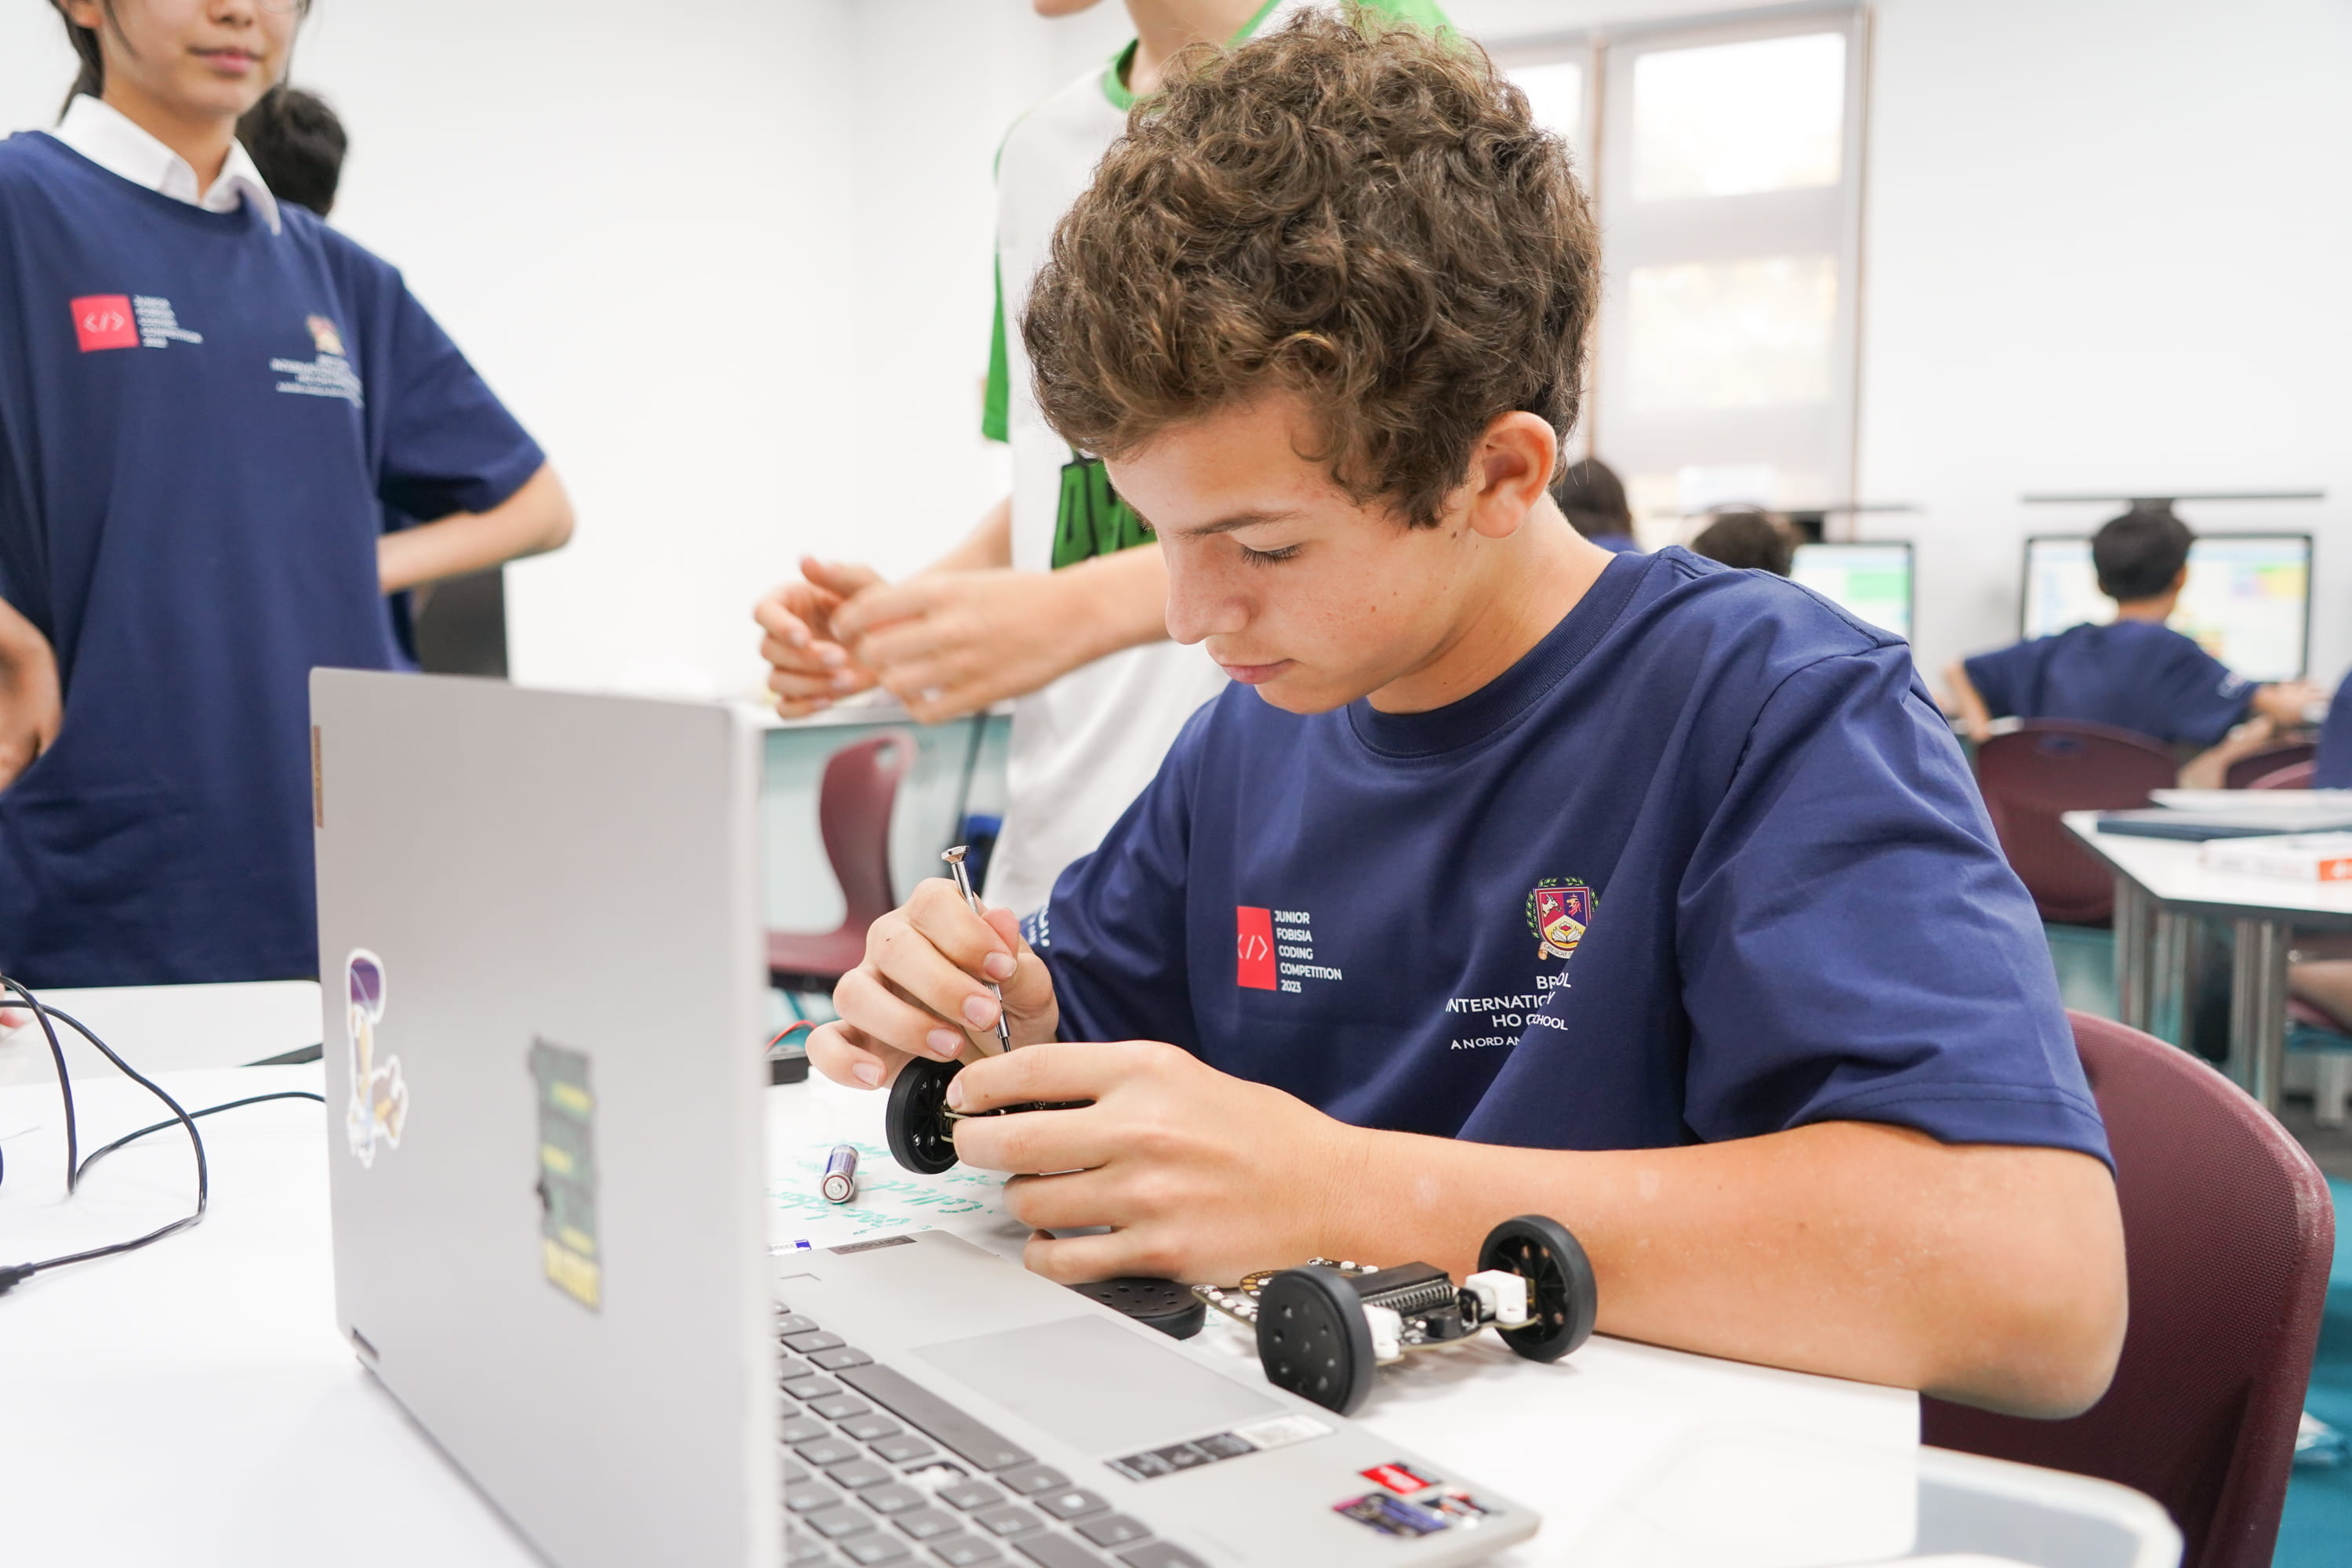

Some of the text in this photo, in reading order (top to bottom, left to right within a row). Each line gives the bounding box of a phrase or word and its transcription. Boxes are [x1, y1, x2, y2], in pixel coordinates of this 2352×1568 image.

[1274, 910, 1310, 924] JUNIOR
[1276, 927, 1312, 942] FOBISIA
[1279, 945, 1313, 960] CODING
[1280, 962, 1342, 980] COMPETITION
[1281, 980, 1301, 993] 2023
[838, 1237, 907, 1252] Lenovo
